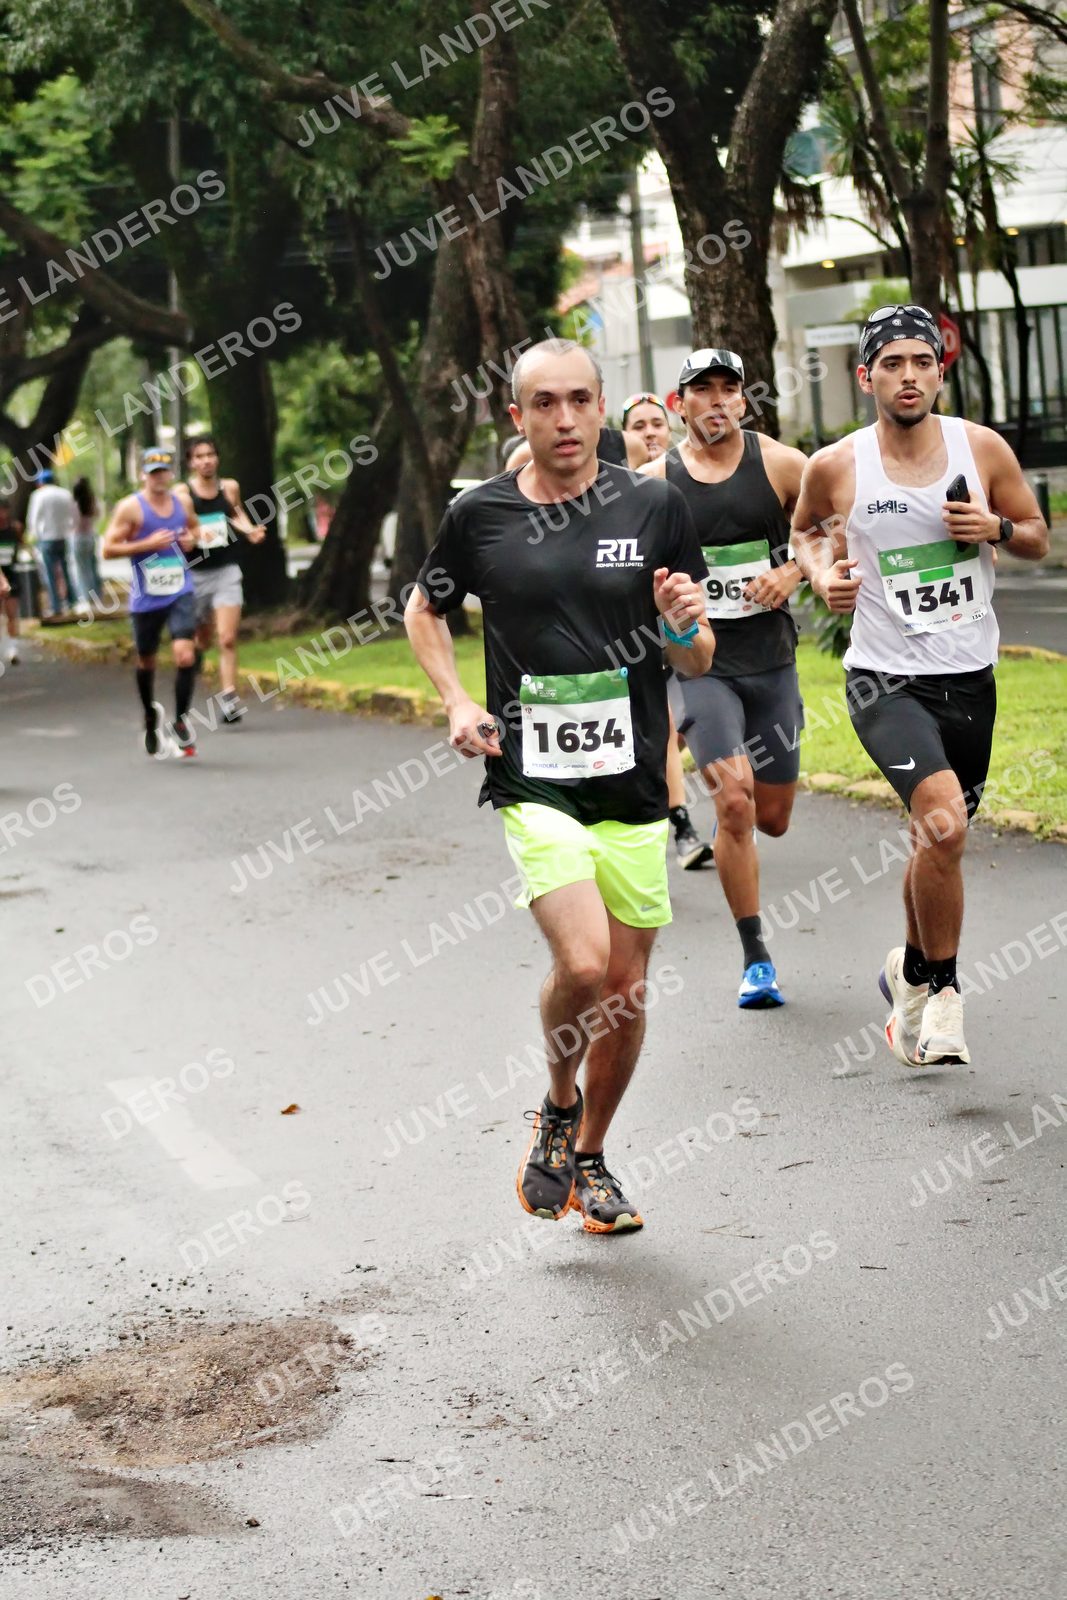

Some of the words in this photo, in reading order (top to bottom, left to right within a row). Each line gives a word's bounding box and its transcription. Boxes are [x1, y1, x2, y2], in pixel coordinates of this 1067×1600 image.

[596, 538, 644, 562] RTL
[895, 576, 974, 616] 1341
[533, 718, 625, 753] 1634
